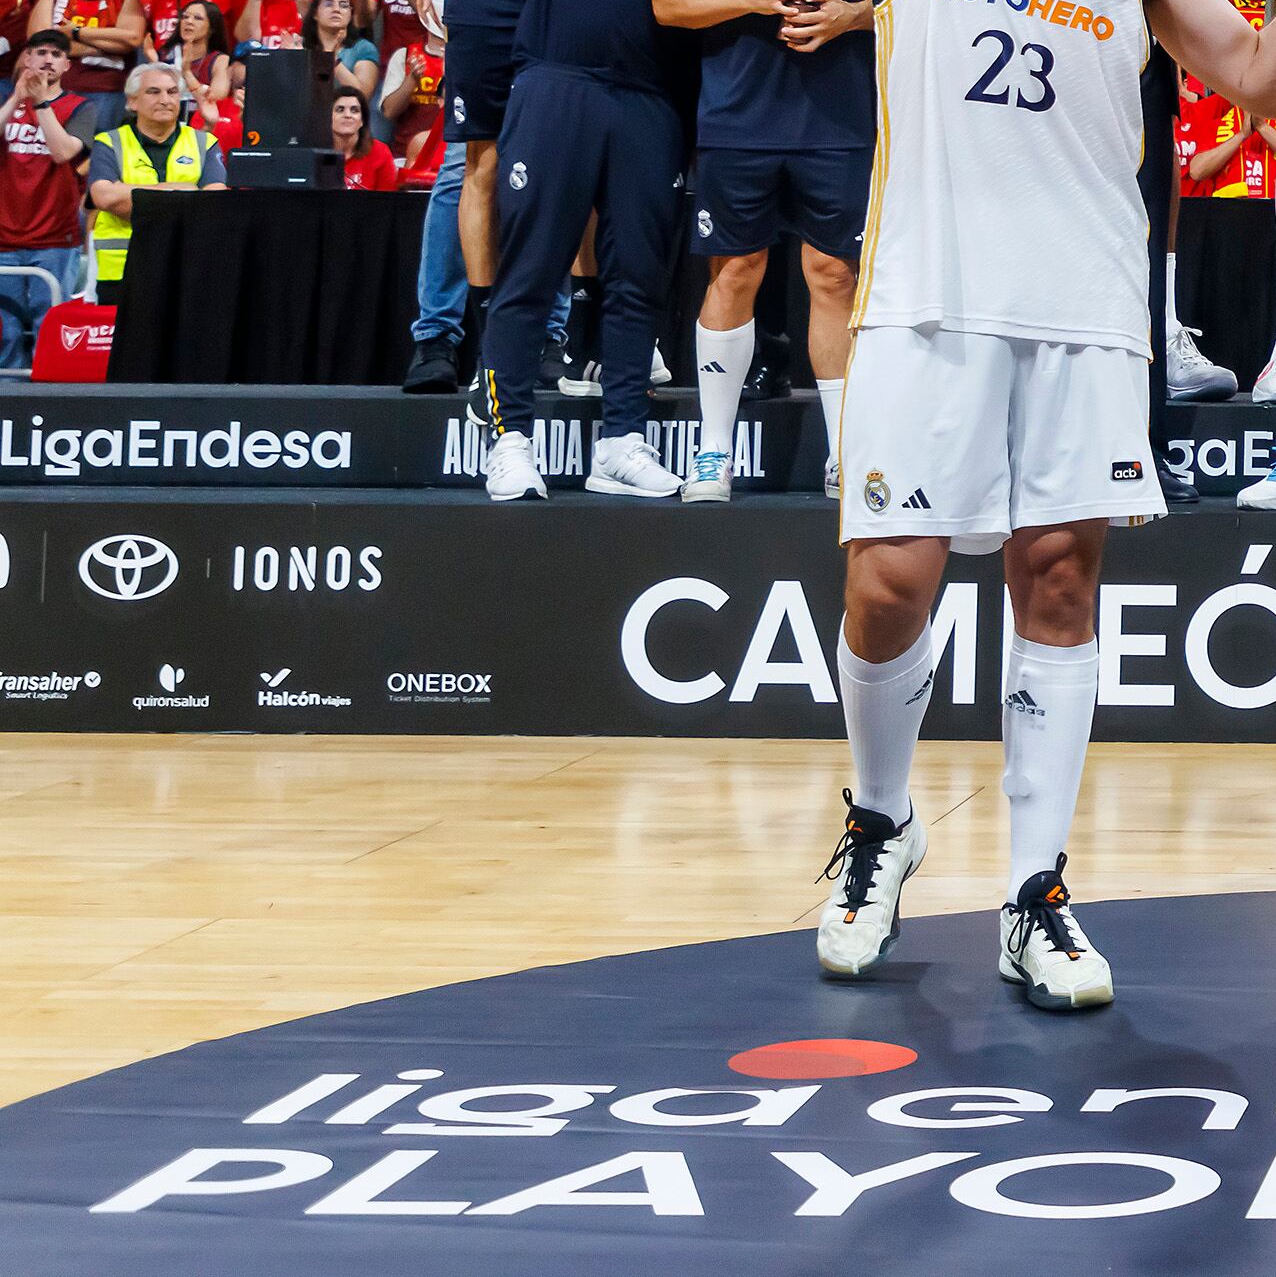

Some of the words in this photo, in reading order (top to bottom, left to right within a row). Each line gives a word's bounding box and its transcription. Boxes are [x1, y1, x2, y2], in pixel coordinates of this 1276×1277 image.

[964, 29, 1056, 112] 23
[1113, 468, 1138, 479] acb
[233, 545, 383, 592] IONOS
[0, 671, 82, 691] ransaher
[386, 673, 492, 693] ONEBOX
[257, 690, 320, 707] Halcón
[321, 695, 352, 707] viajes
[241, 1069, 823, 1136] liga
